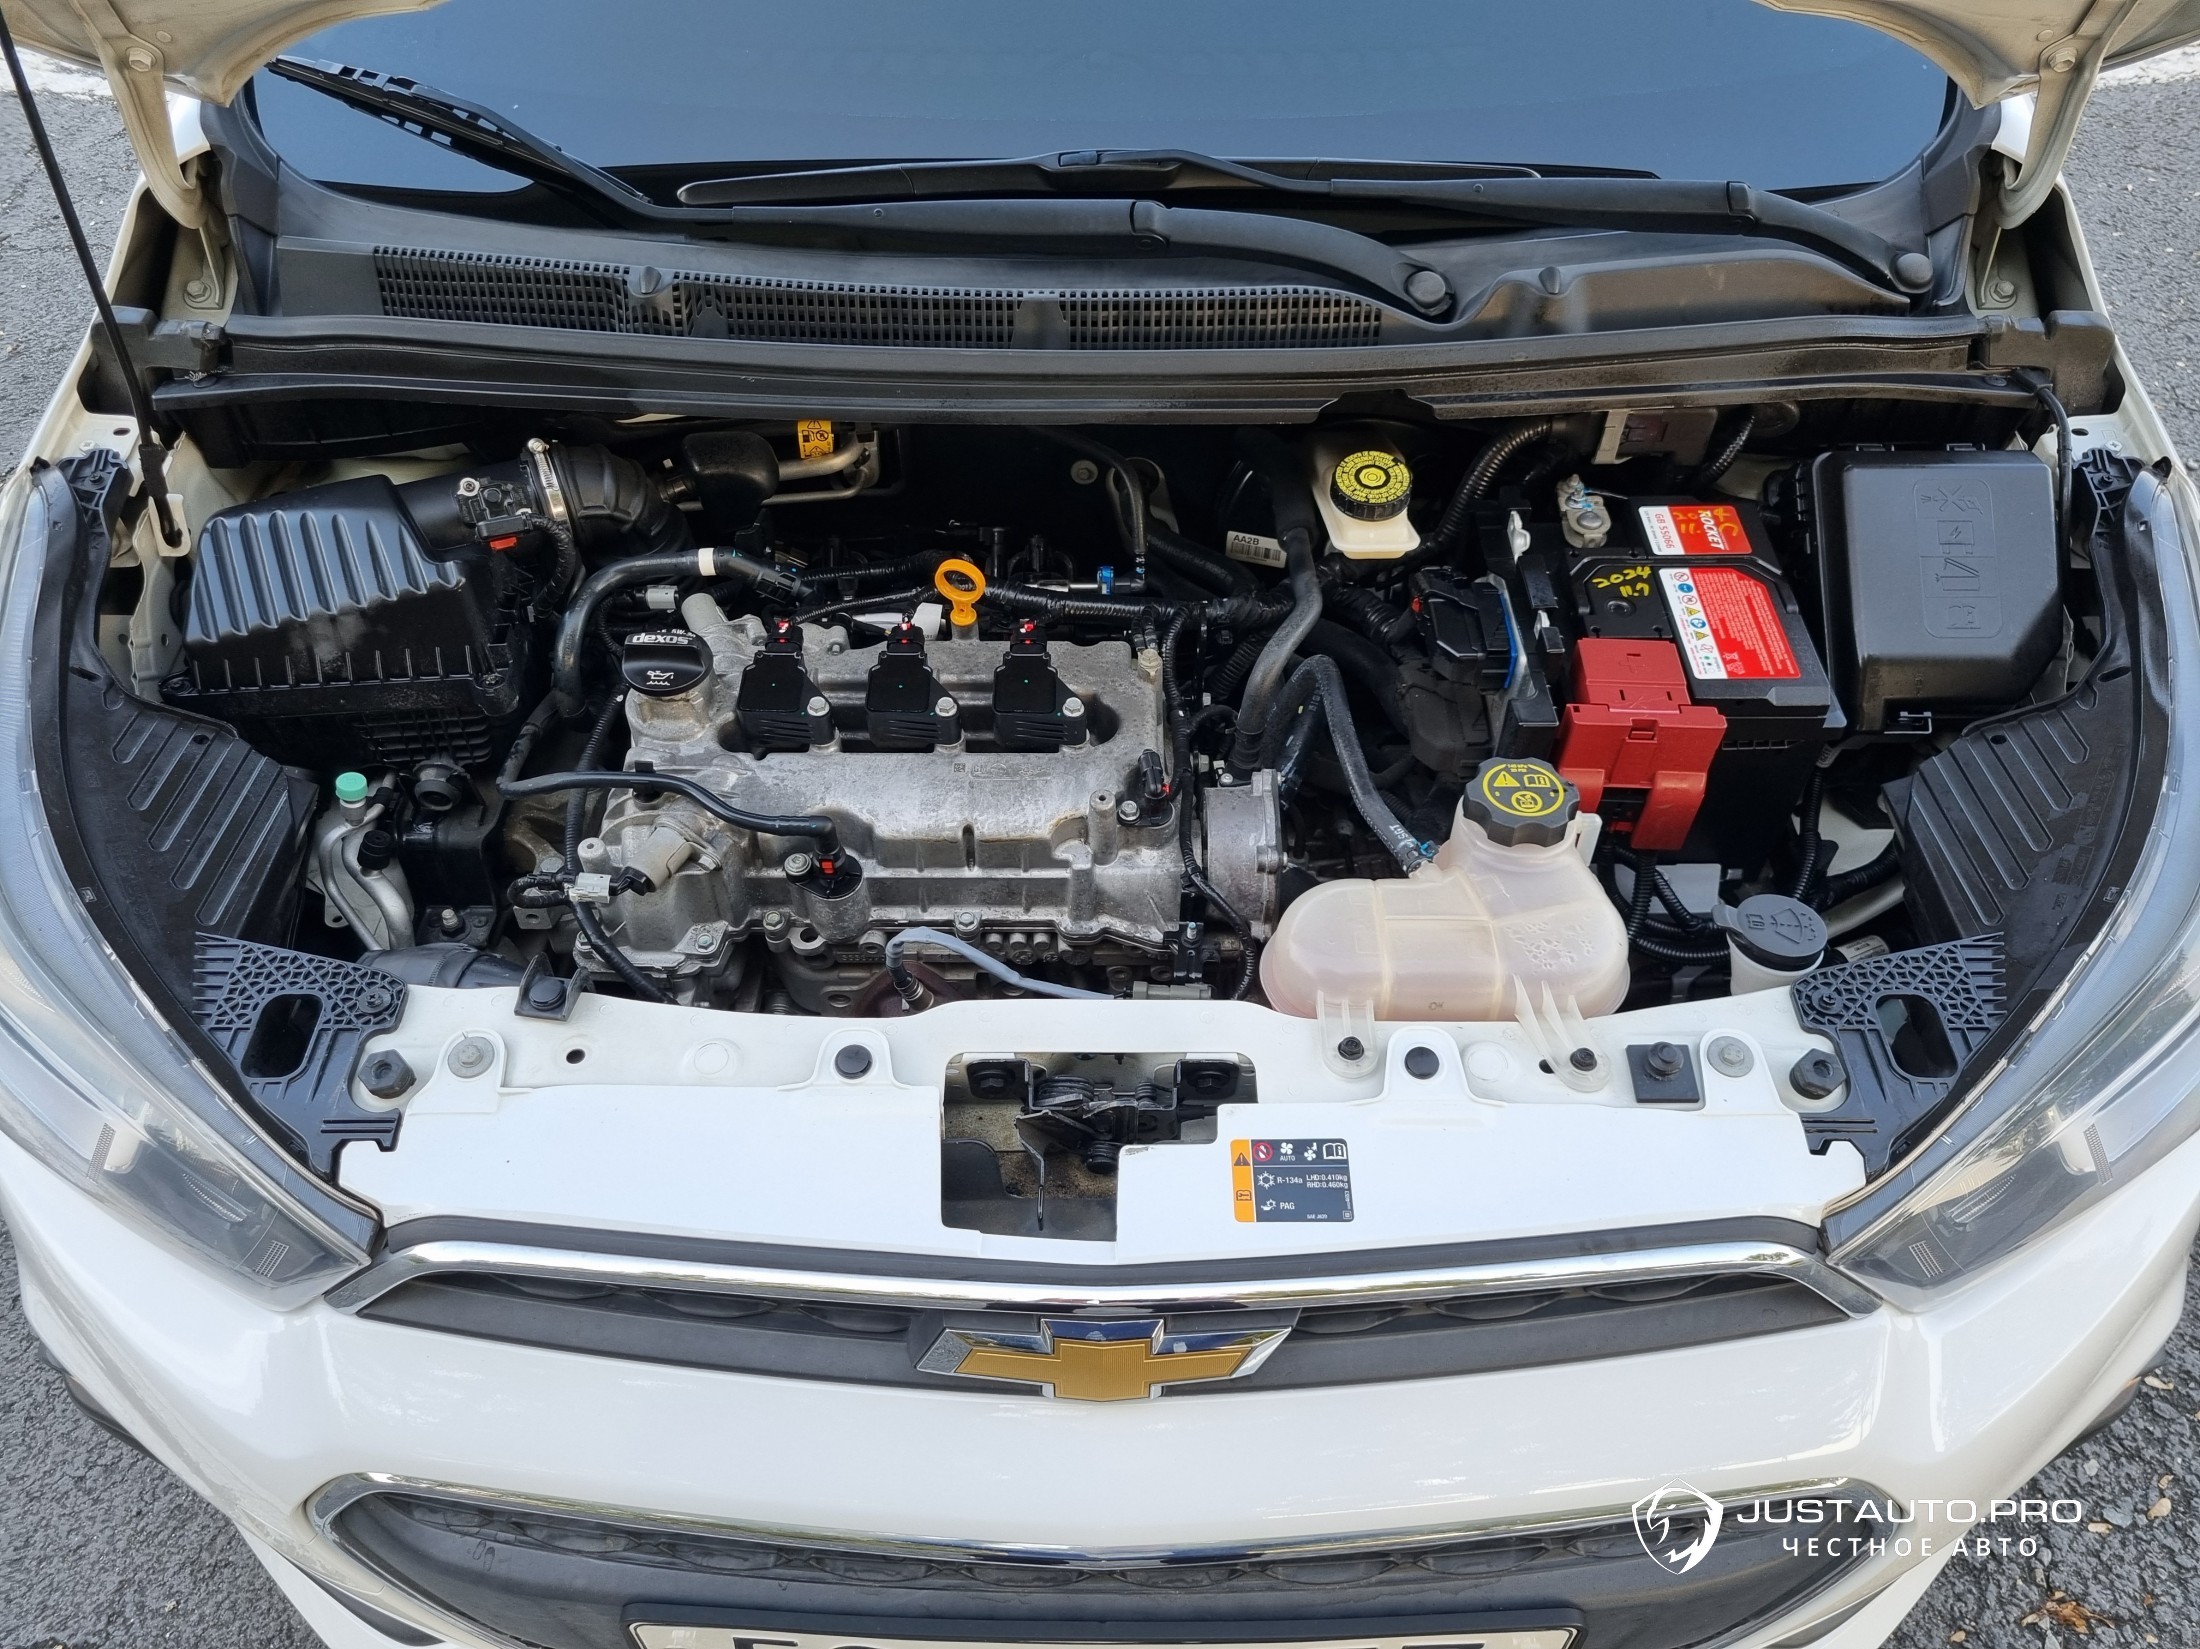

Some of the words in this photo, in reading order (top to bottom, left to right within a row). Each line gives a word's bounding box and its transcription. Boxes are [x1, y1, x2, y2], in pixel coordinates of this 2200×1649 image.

[1655, 513, 1666, 524] GB
[1699, 509, 1725, 550] ROCKET
[1233, 534, 1260, 546] AA2B
[1592, 566, 1651, 588] 2024
[632, 633, 690, 645] dexos
[1277, 1176, 1303, 1184] R-134a
[1280, 1202, 1296, 1210] PAG
